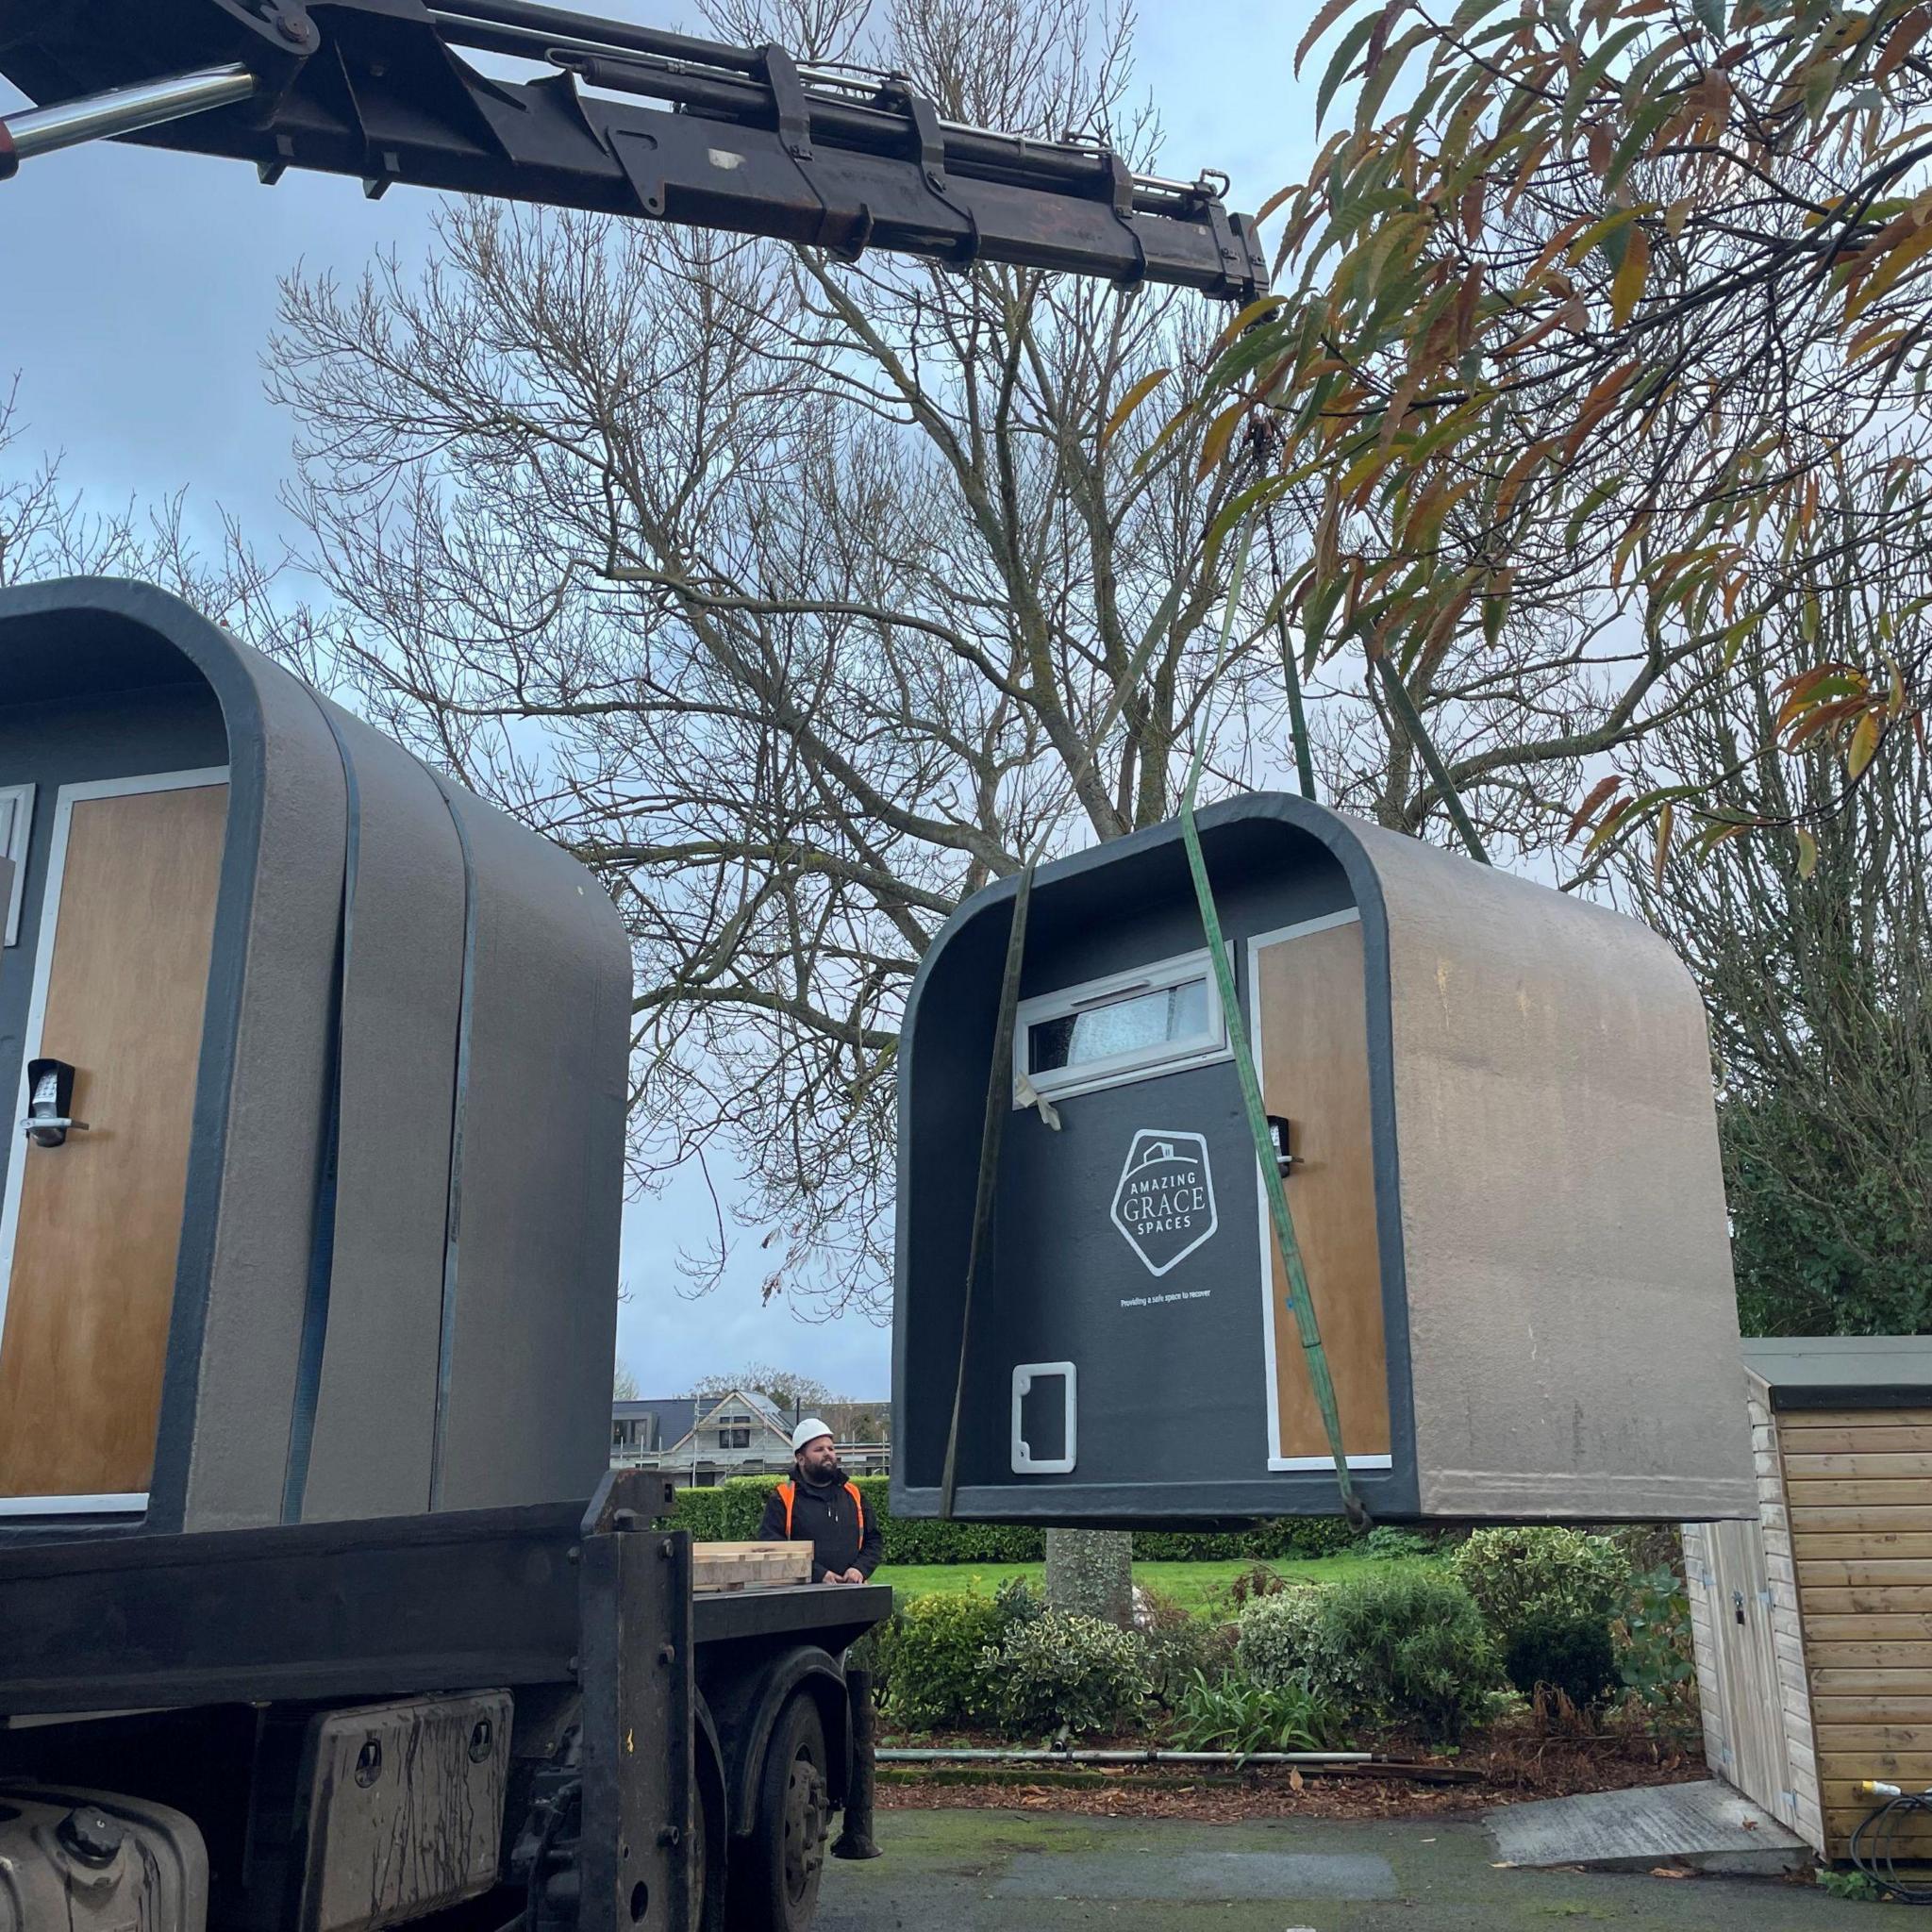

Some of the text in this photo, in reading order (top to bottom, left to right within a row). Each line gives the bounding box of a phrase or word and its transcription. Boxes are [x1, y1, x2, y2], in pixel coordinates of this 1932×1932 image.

[1131, 1173, 1196, 1194] AMAZING
[1124, 1187, 1206, 1222] GRACE
[1138, 1216, 1191, 1235] SPACES
[1121, 1297, 1146, 1307] Providing
[1152, 1294, 1165, 1303] safe
[1165, 1293, 1181, 1302] space
[1190, 1290, 1210, 1298] recover
